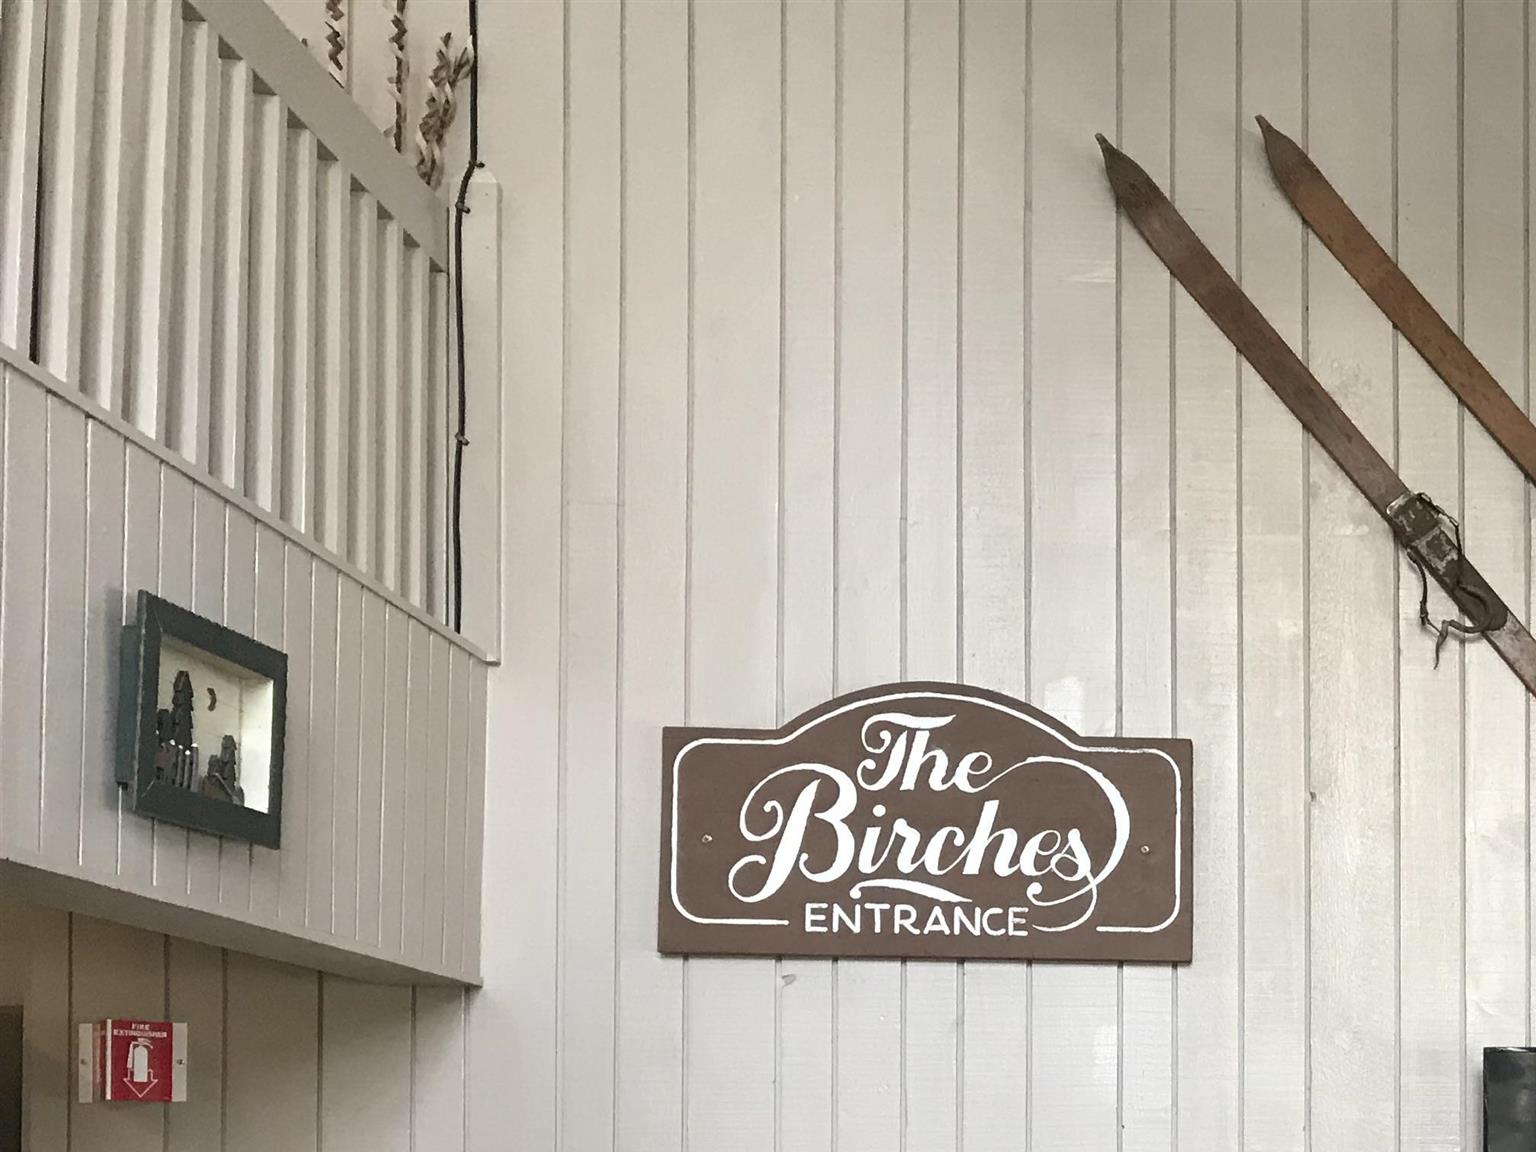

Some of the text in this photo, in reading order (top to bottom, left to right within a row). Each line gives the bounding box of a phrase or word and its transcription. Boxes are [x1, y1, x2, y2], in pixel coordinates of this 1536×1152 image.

[856, 712, 993, 793] The
[728, 762, 1097, 904] Birches
[804, 901, 1030, 937] ENTRANCE
[131, 1023, 151, 1031] FIRE
